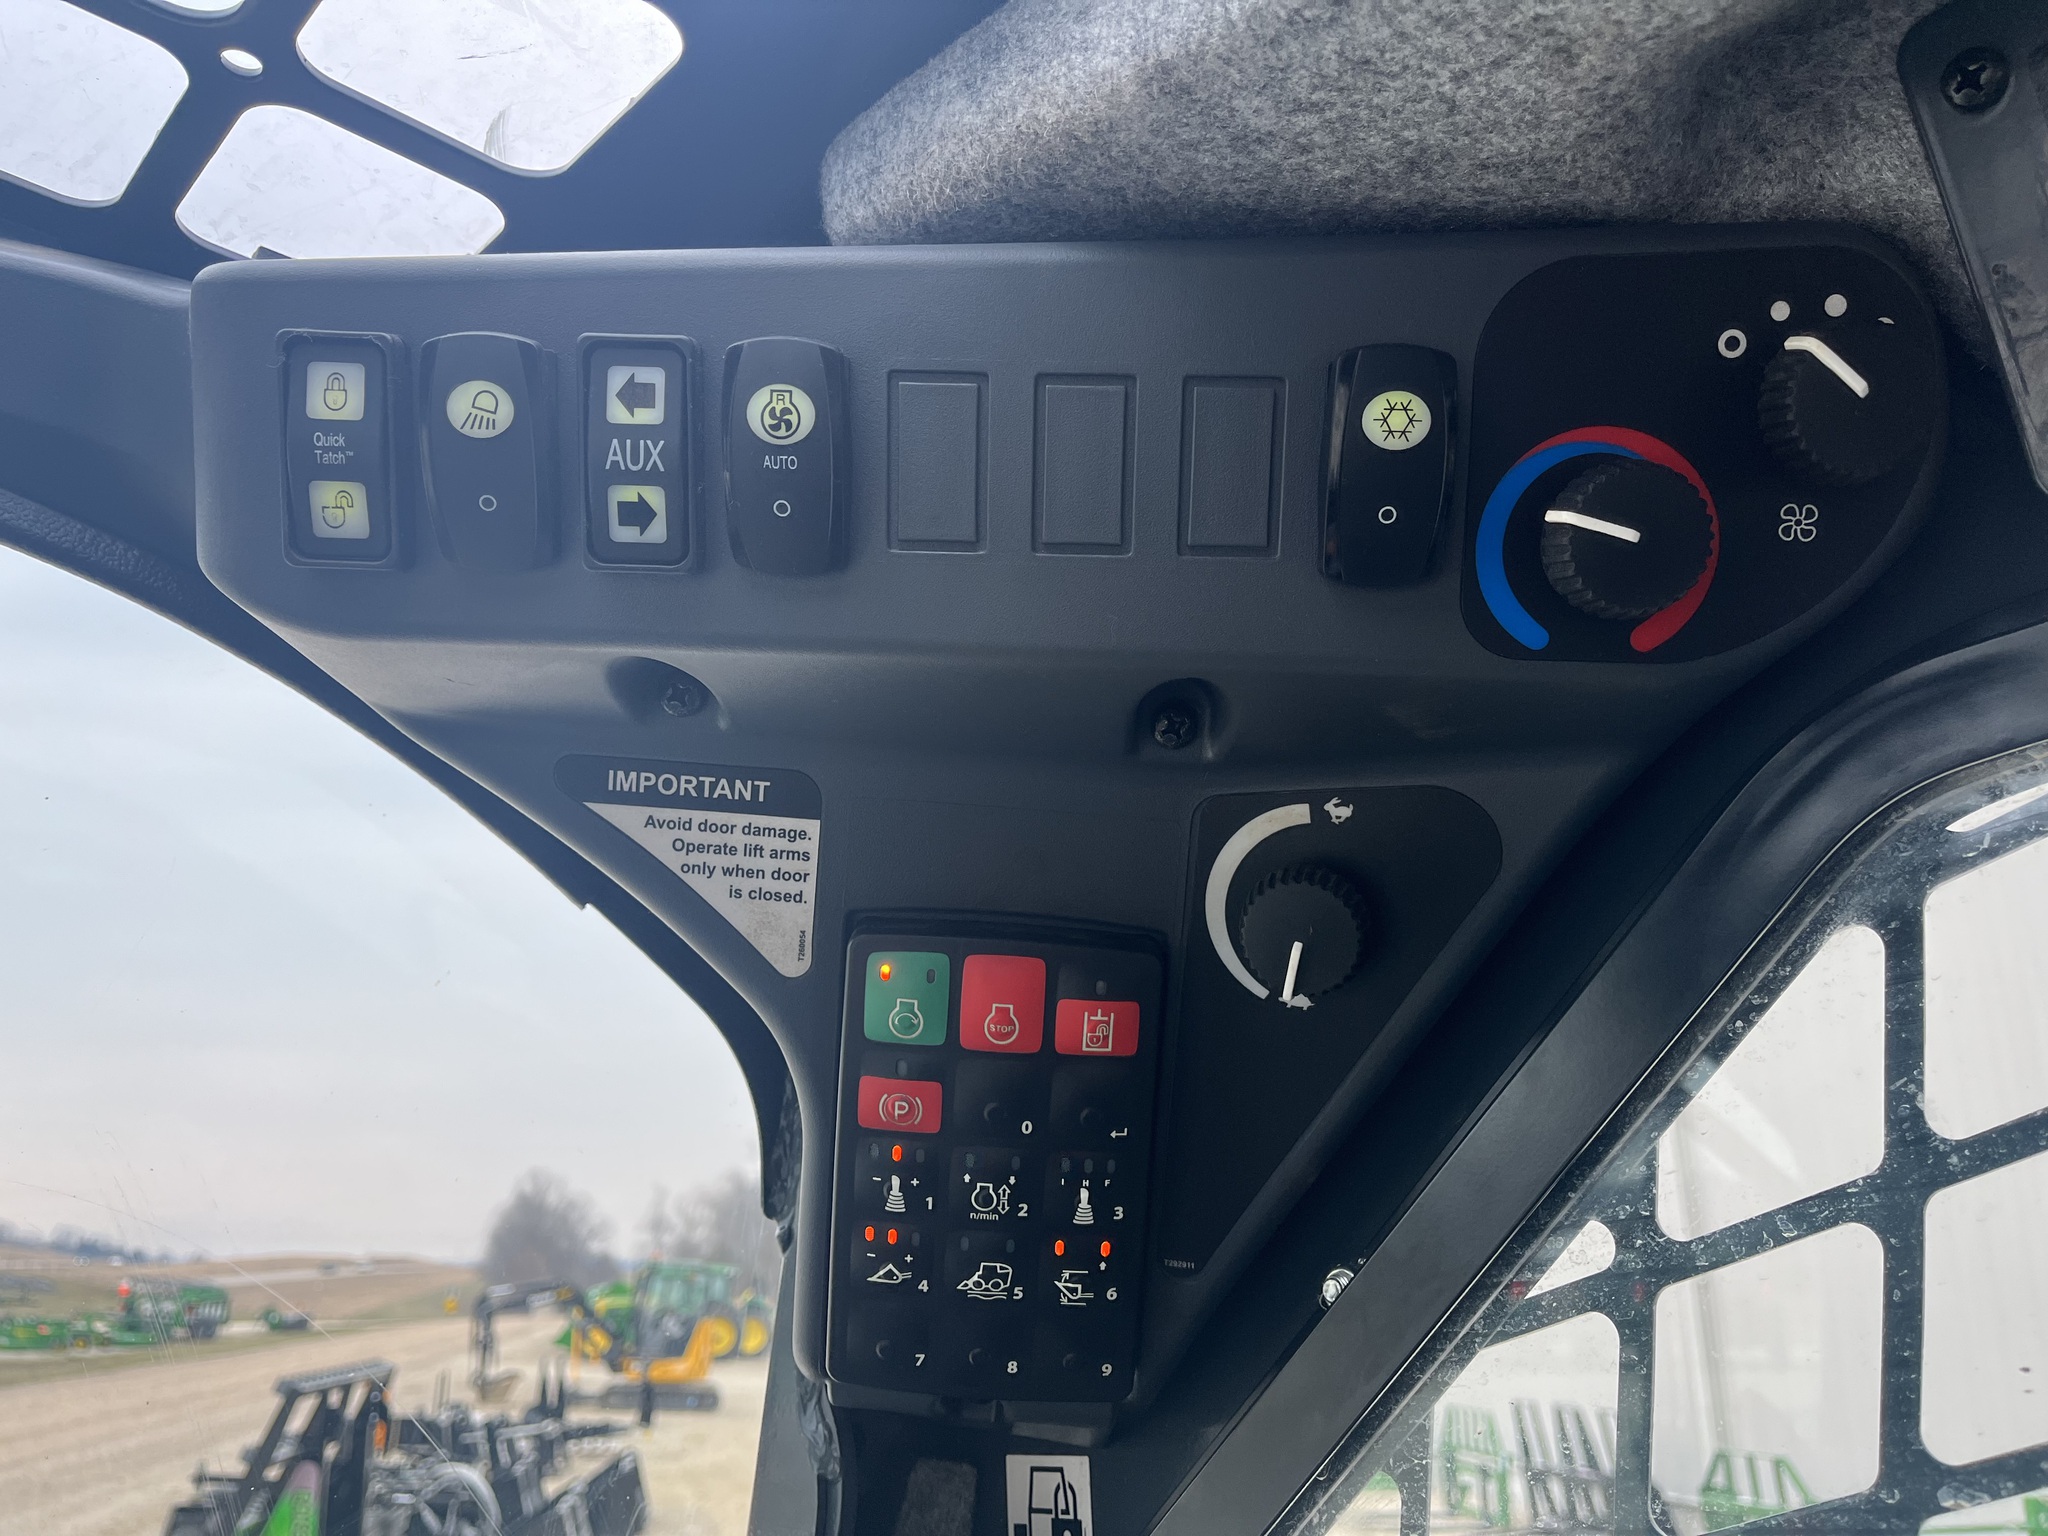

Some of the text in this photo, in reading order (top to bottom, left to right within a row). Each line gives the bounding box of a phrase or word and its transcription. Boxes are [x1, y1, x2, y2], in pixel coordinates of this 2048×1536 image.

[776, 393, 786, 406] R
[313, 431, 346, 447] Quick
[605, 439, 665, 473] AUX
[762, 455, 798, 470] AUTO
[607, 769, 771, 803] IMPORTANT
[643, 814, 812, 842] Avoid door damage.
[671, 837, 811, 863] Operate lift arms
[680, 861, 811, 884] only when door
[728, 885, 808, 904] is closed.
[989, 1024, 1015, 1034] STOP
[893, 1101, 910, 1121] P
[1021, 1120, 1034, 1135] 0
[1082, 1179, 1090, 1187] H
[1104, 1179, 1111, 1187] F
[925, 1196, 934, 1210] 1
[969, 1211, 999, 1222] n/min
[1017, 1203, 1029, 1218] 2
[1113, 1206, 1125, 1220] 3
[917, 1279, 930, 1293] 4
[1012, 1286, 1024, 1300] 5
[1106, 1287, 1118, 1301] 6
[914, 1354, 926, 1367] 7
[1006, 1360, 1019, 1374] 8
[1101, 1363, 1113, 1377] 9
